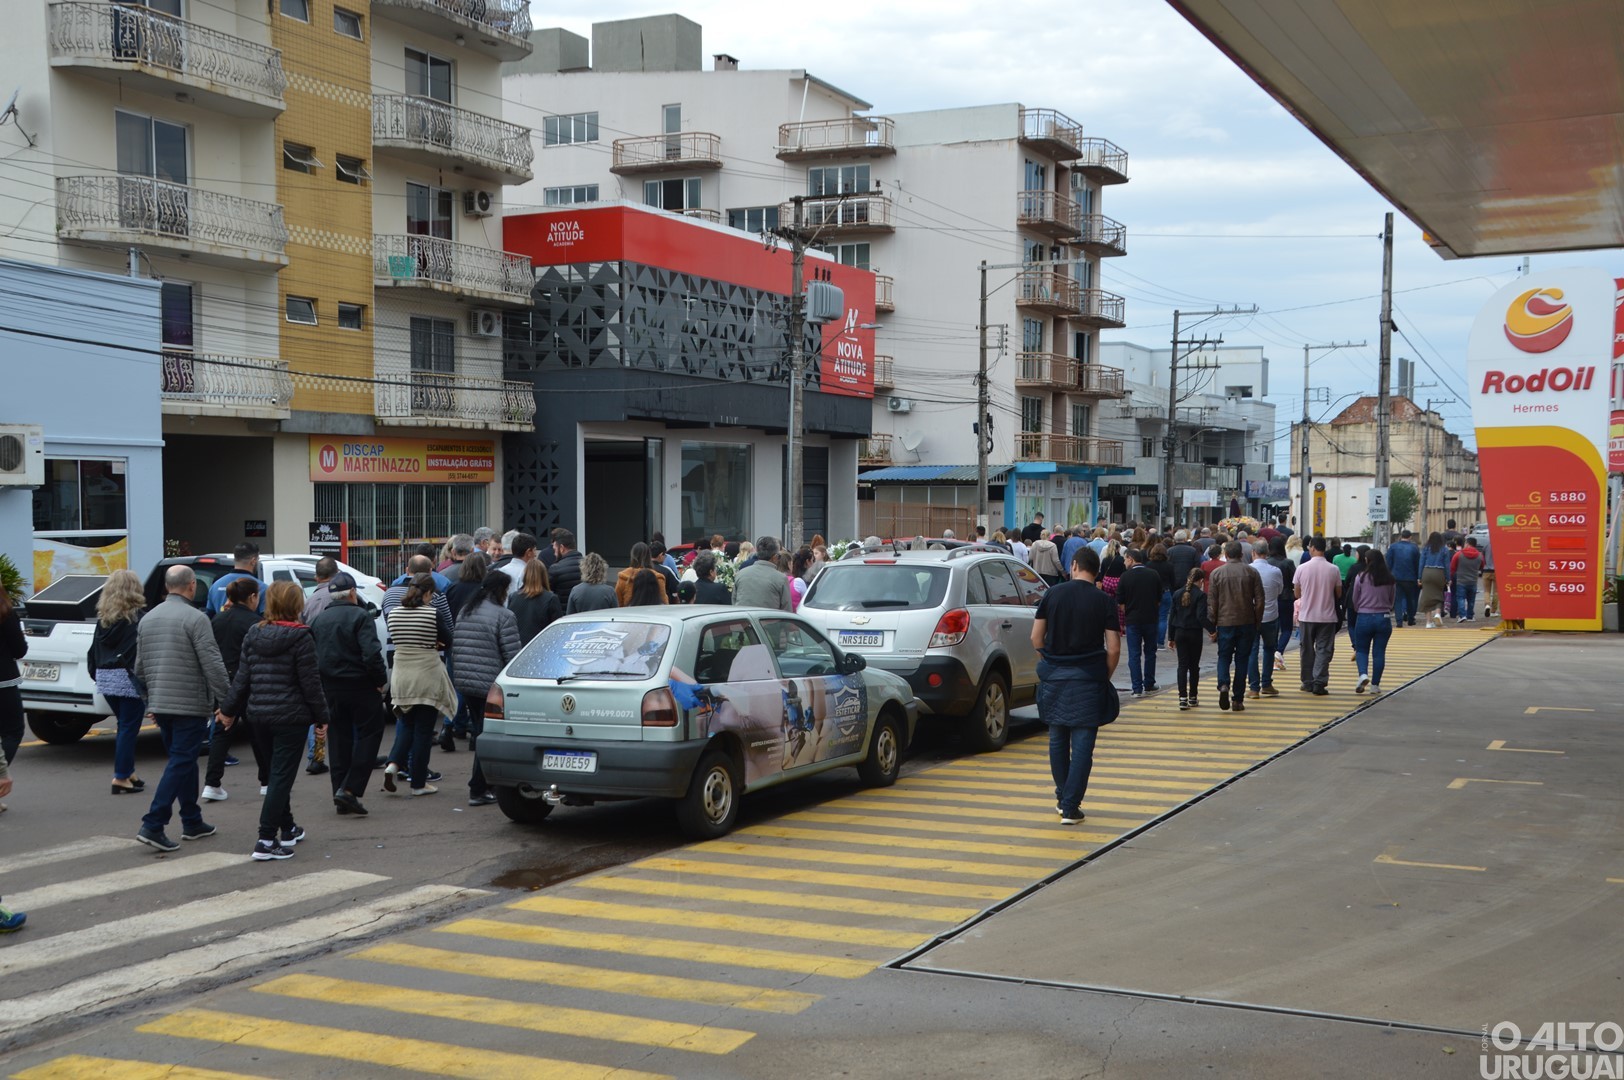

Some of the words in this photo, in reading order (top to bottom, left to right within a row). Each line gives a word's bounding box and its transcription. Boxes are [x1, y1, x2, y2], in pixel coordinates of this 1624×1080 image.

[550, 221, 580, 232] NOVA
[547, 230, 584, 242] ATITUDE
[838, 341, 863, 359] NOVA
[834, 358, 867, 377] ATITUDE
[1481, 366, 1596, 394] RodOil
[1513, 404, 1559, 413] Hermes
[343, 443, 385, 456] DISCAP
[343, 457, 420, 473] MARTINAZZO
[427, 458, 468, 469] INSTALAÇÃO
[469, 458, 492, 468] GRÁTIS
[1529, 491, 1542, 503] G
[1550, 492, 1586, 502] 5.880
[1515, 514, 1541, 526] GA
[1549, 515, 1585, 524] 6.040
[1531, 537, 1541, 548] E
[1516, 561, 1541, 570] S-10
[1549, 561, 1586, 570] 5.790
[1505, 583, 1541, 592] S-500
[1549, 583, 1585, 593] 5.690
[563, 642, 619, 650] ESTETICAR
[842, 635, 879, 645] NRS1E08
[546, 755, 591, 770] CAV8E59
